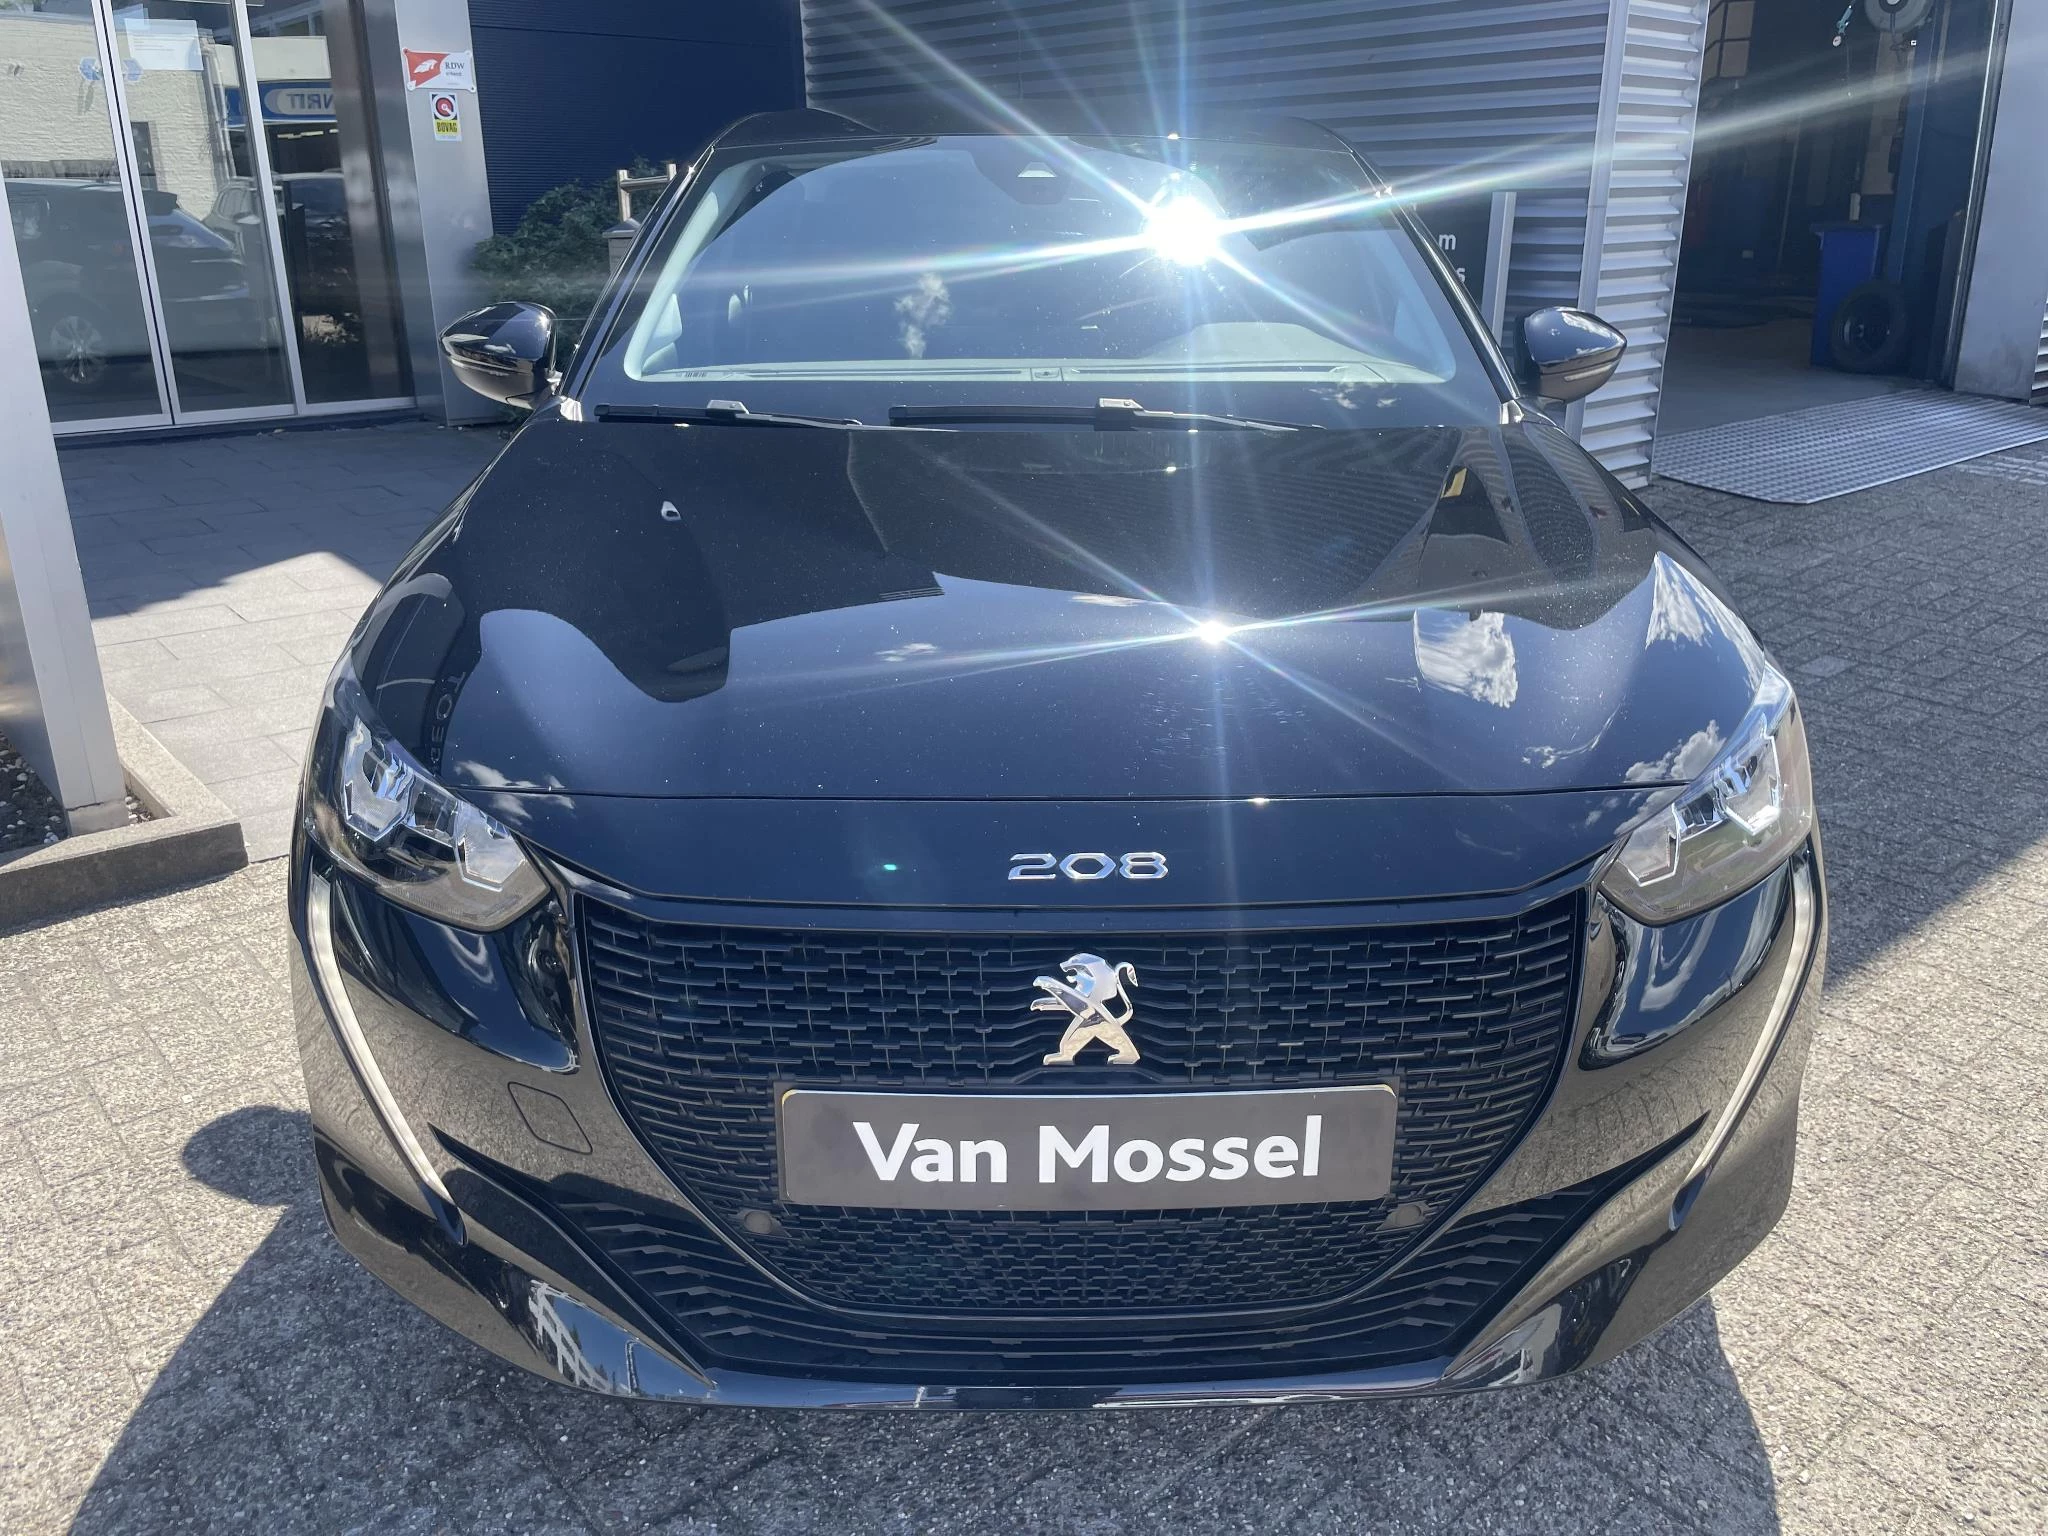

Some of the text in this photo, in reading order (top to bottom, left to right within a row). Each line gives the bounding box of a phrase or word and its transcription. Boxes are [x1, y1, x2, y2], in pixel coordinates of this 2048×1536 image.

[445, 61, 465, 70] RDW
[436, 121, 458, 133] BOVAG
[1008, 851, 1169, 880] 208
[853, 1115, 1323, 1183] Van Mossel
